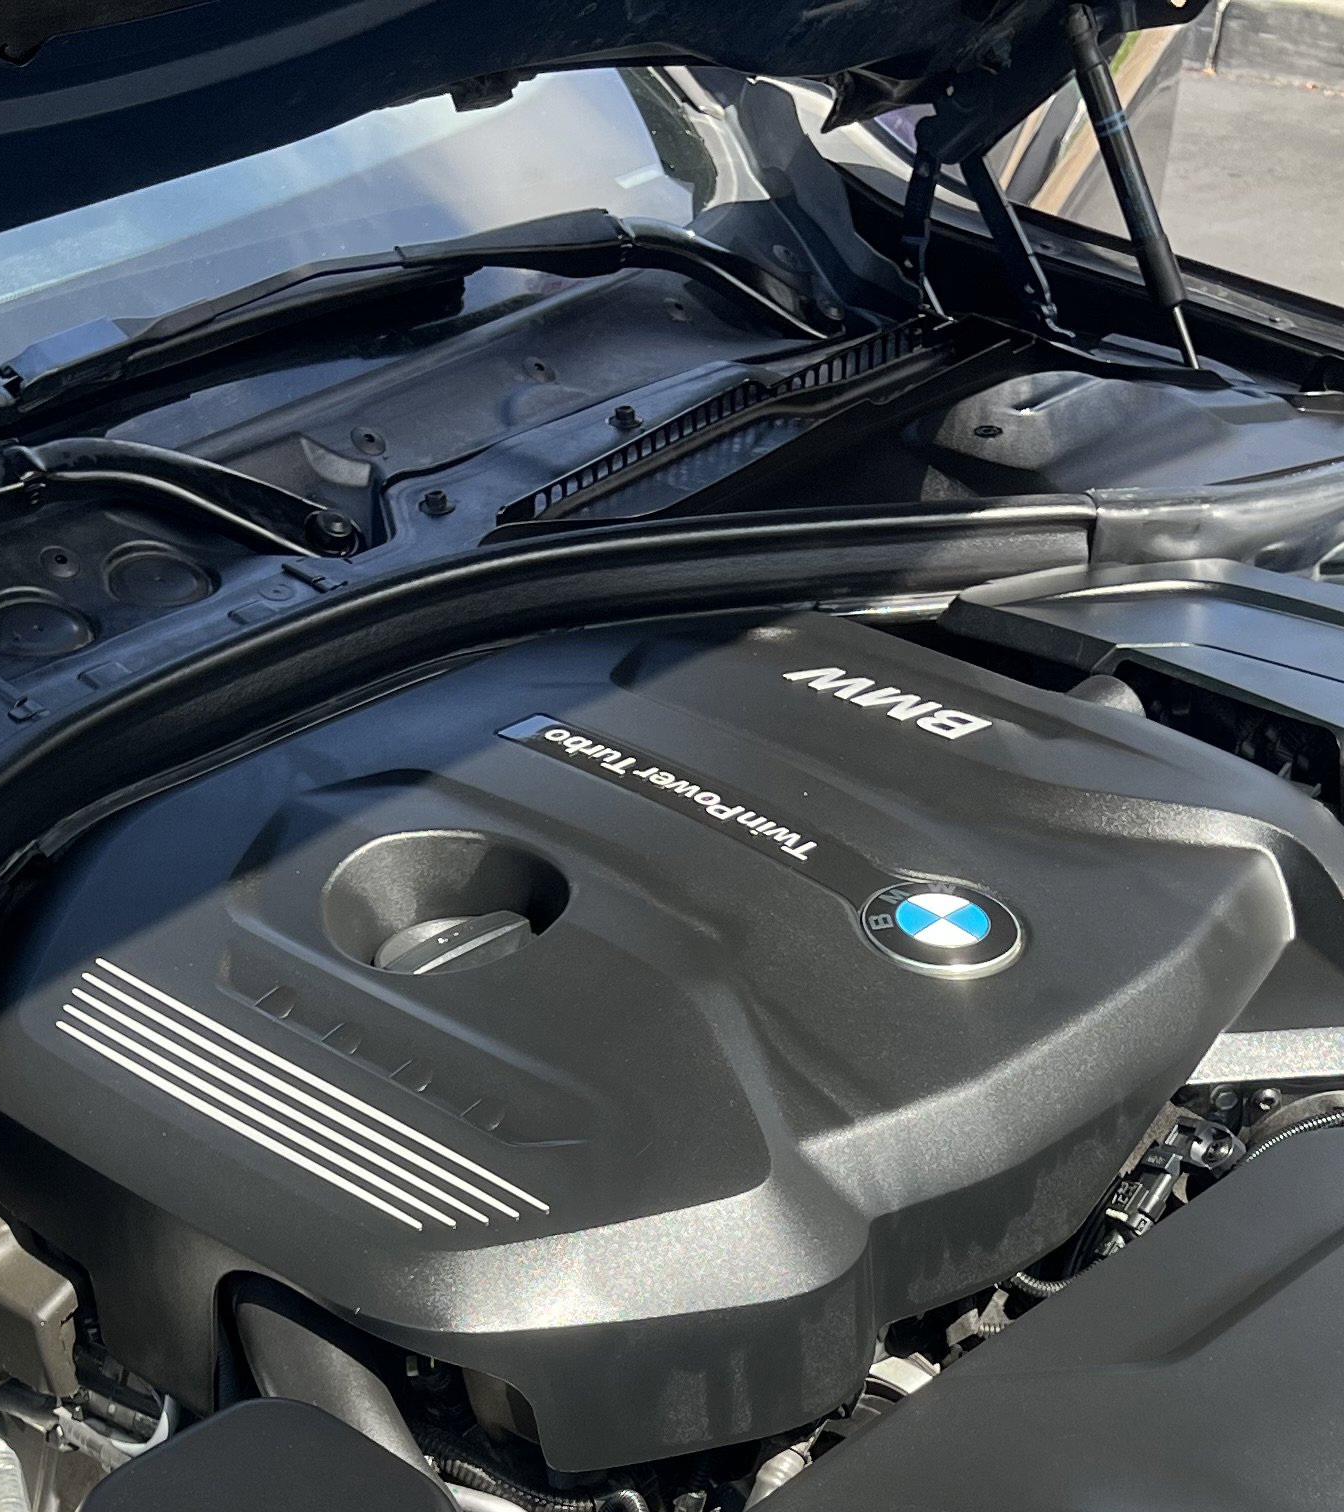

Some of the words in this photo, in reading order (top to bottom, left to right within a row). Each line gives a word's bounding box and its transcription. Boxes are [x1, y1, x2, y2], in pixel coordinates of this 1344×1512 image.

[782, 667, 993, 740] BMW
[543, 727, 631, 776] Turbo
[634, 765, 818, 862] TwinPower
[869, 881, 957, 931] BMW
